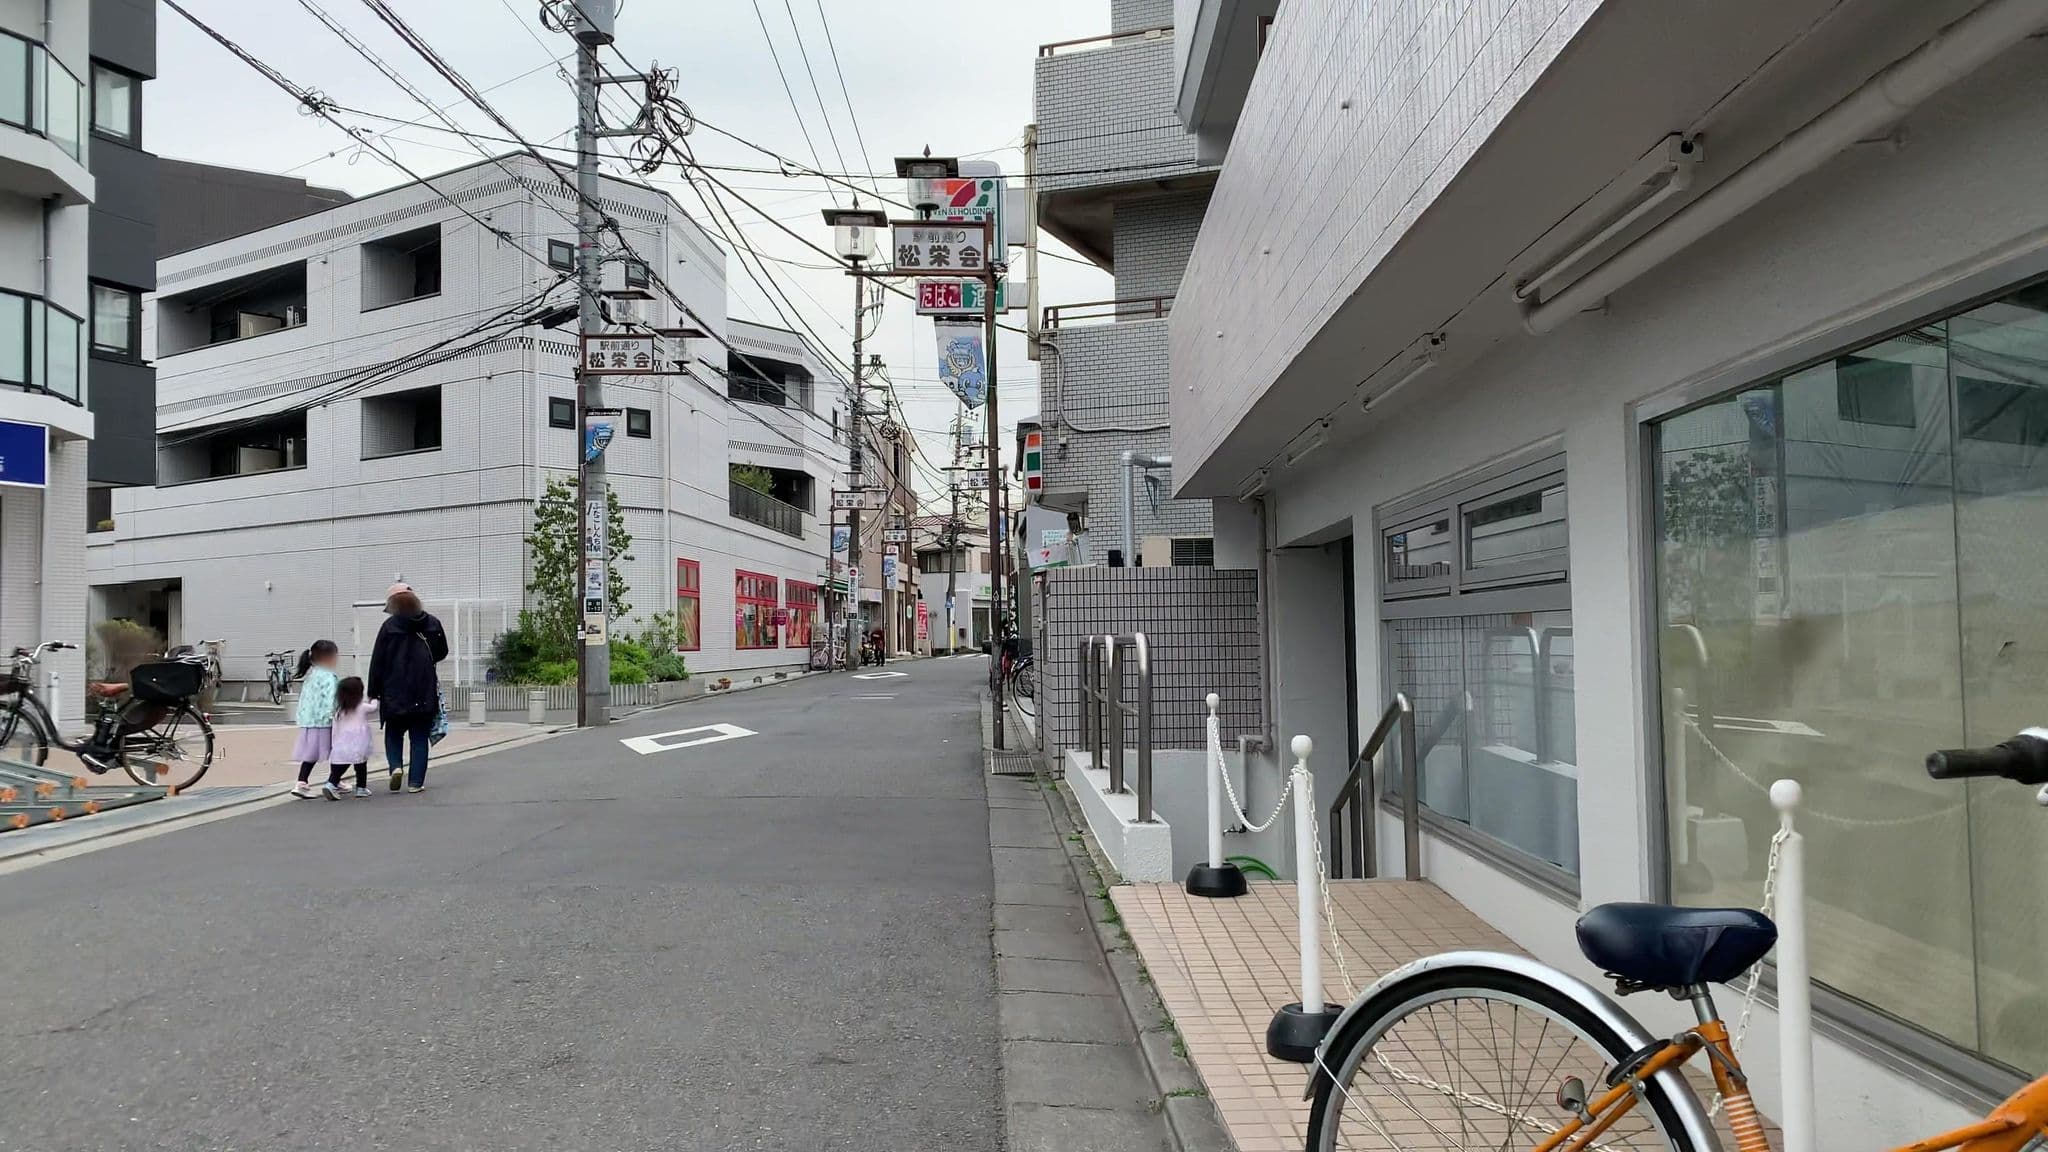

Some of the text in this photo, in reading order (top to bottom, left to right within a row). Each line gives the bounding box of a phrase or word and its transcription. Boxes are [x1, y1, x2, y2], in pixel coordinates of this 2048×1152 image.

[899, 244, 982, 267] 松栄会
[921, 284, 960, 307] たばこ
[600, 340, 640, 350] 駅前通り
[589, 351, 650, 368] 松栄会
